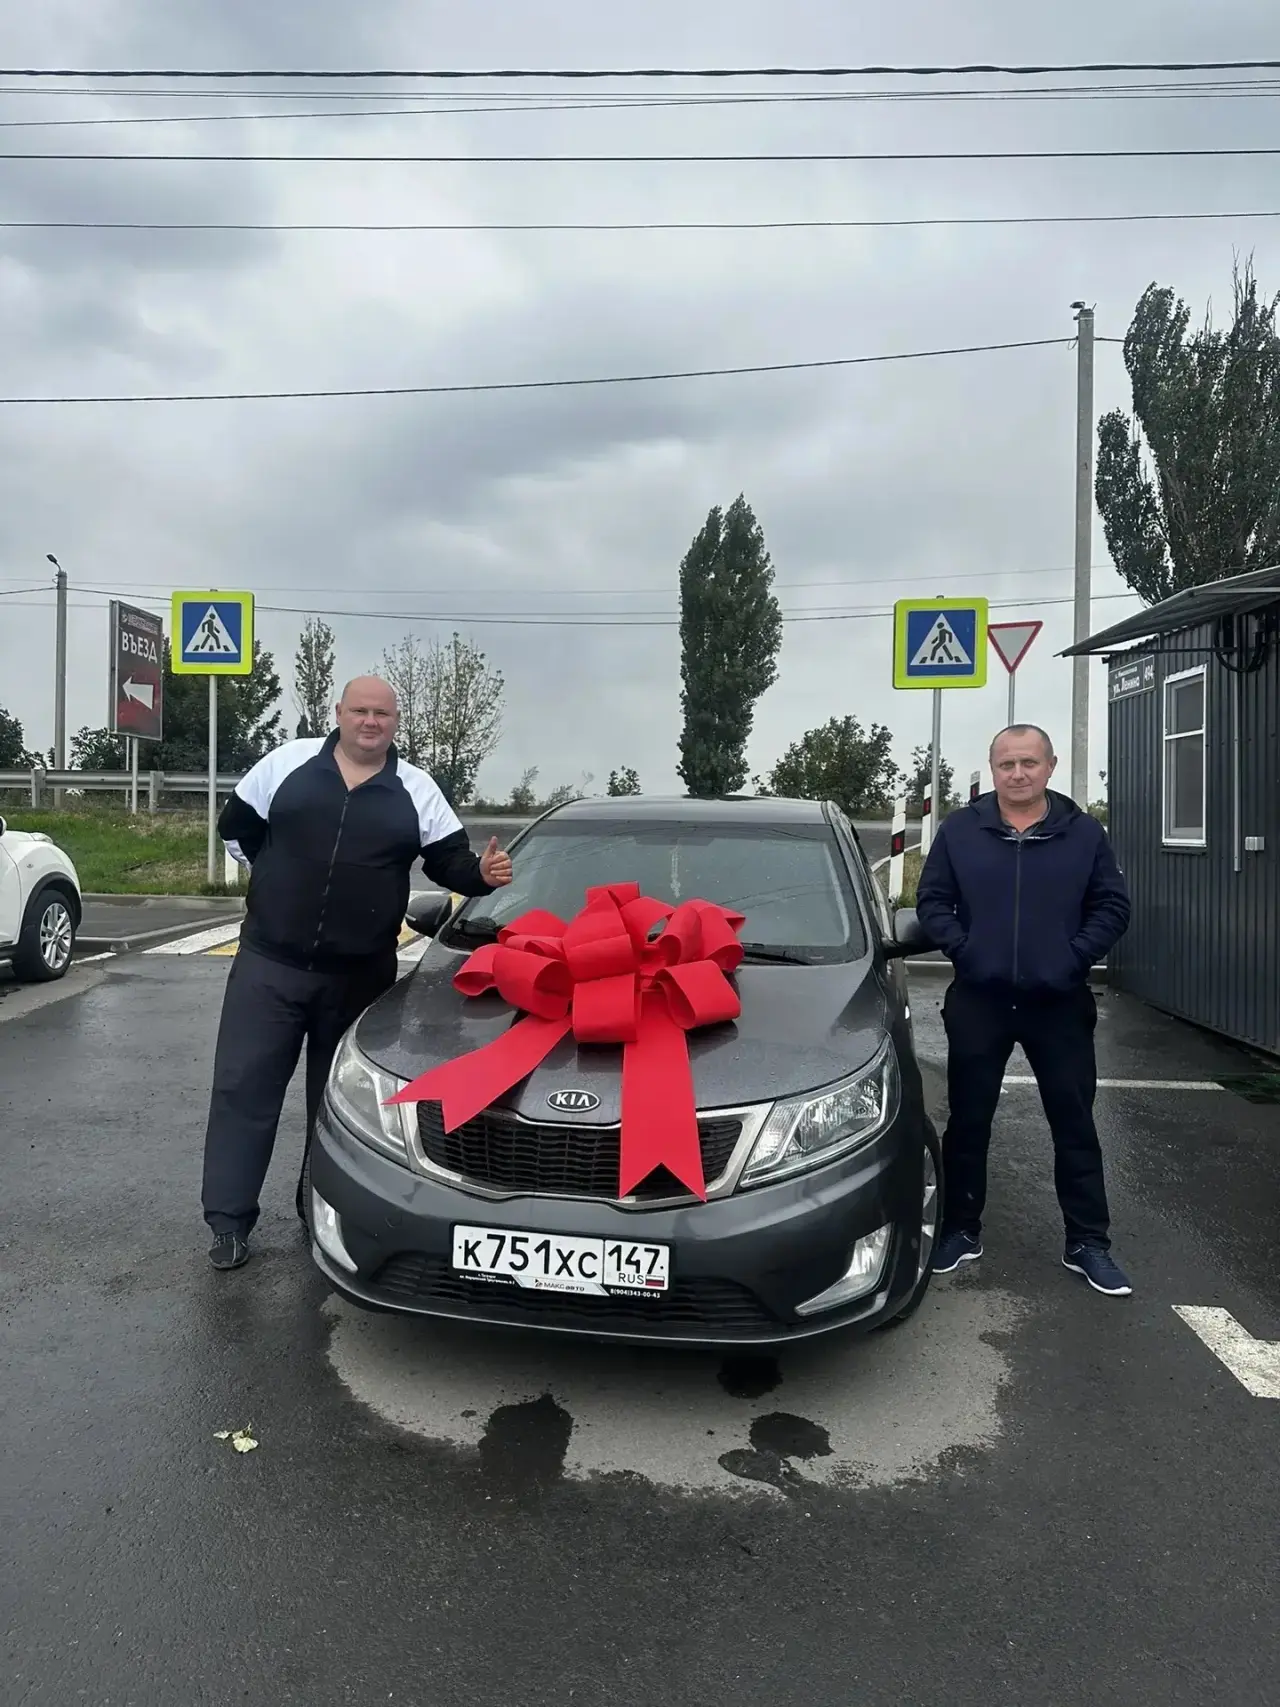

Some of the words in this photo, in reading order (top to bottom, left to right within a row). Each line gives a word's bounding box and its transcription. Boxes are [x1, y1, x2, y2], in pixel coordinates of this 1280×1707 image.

[122, 631, 158, 664] ВЪЕЗД
[555, 1092, 590, 1107] KIA
[607, 1244, 661, 1275] 147
[618, 1272, 645, 1285] RUS
